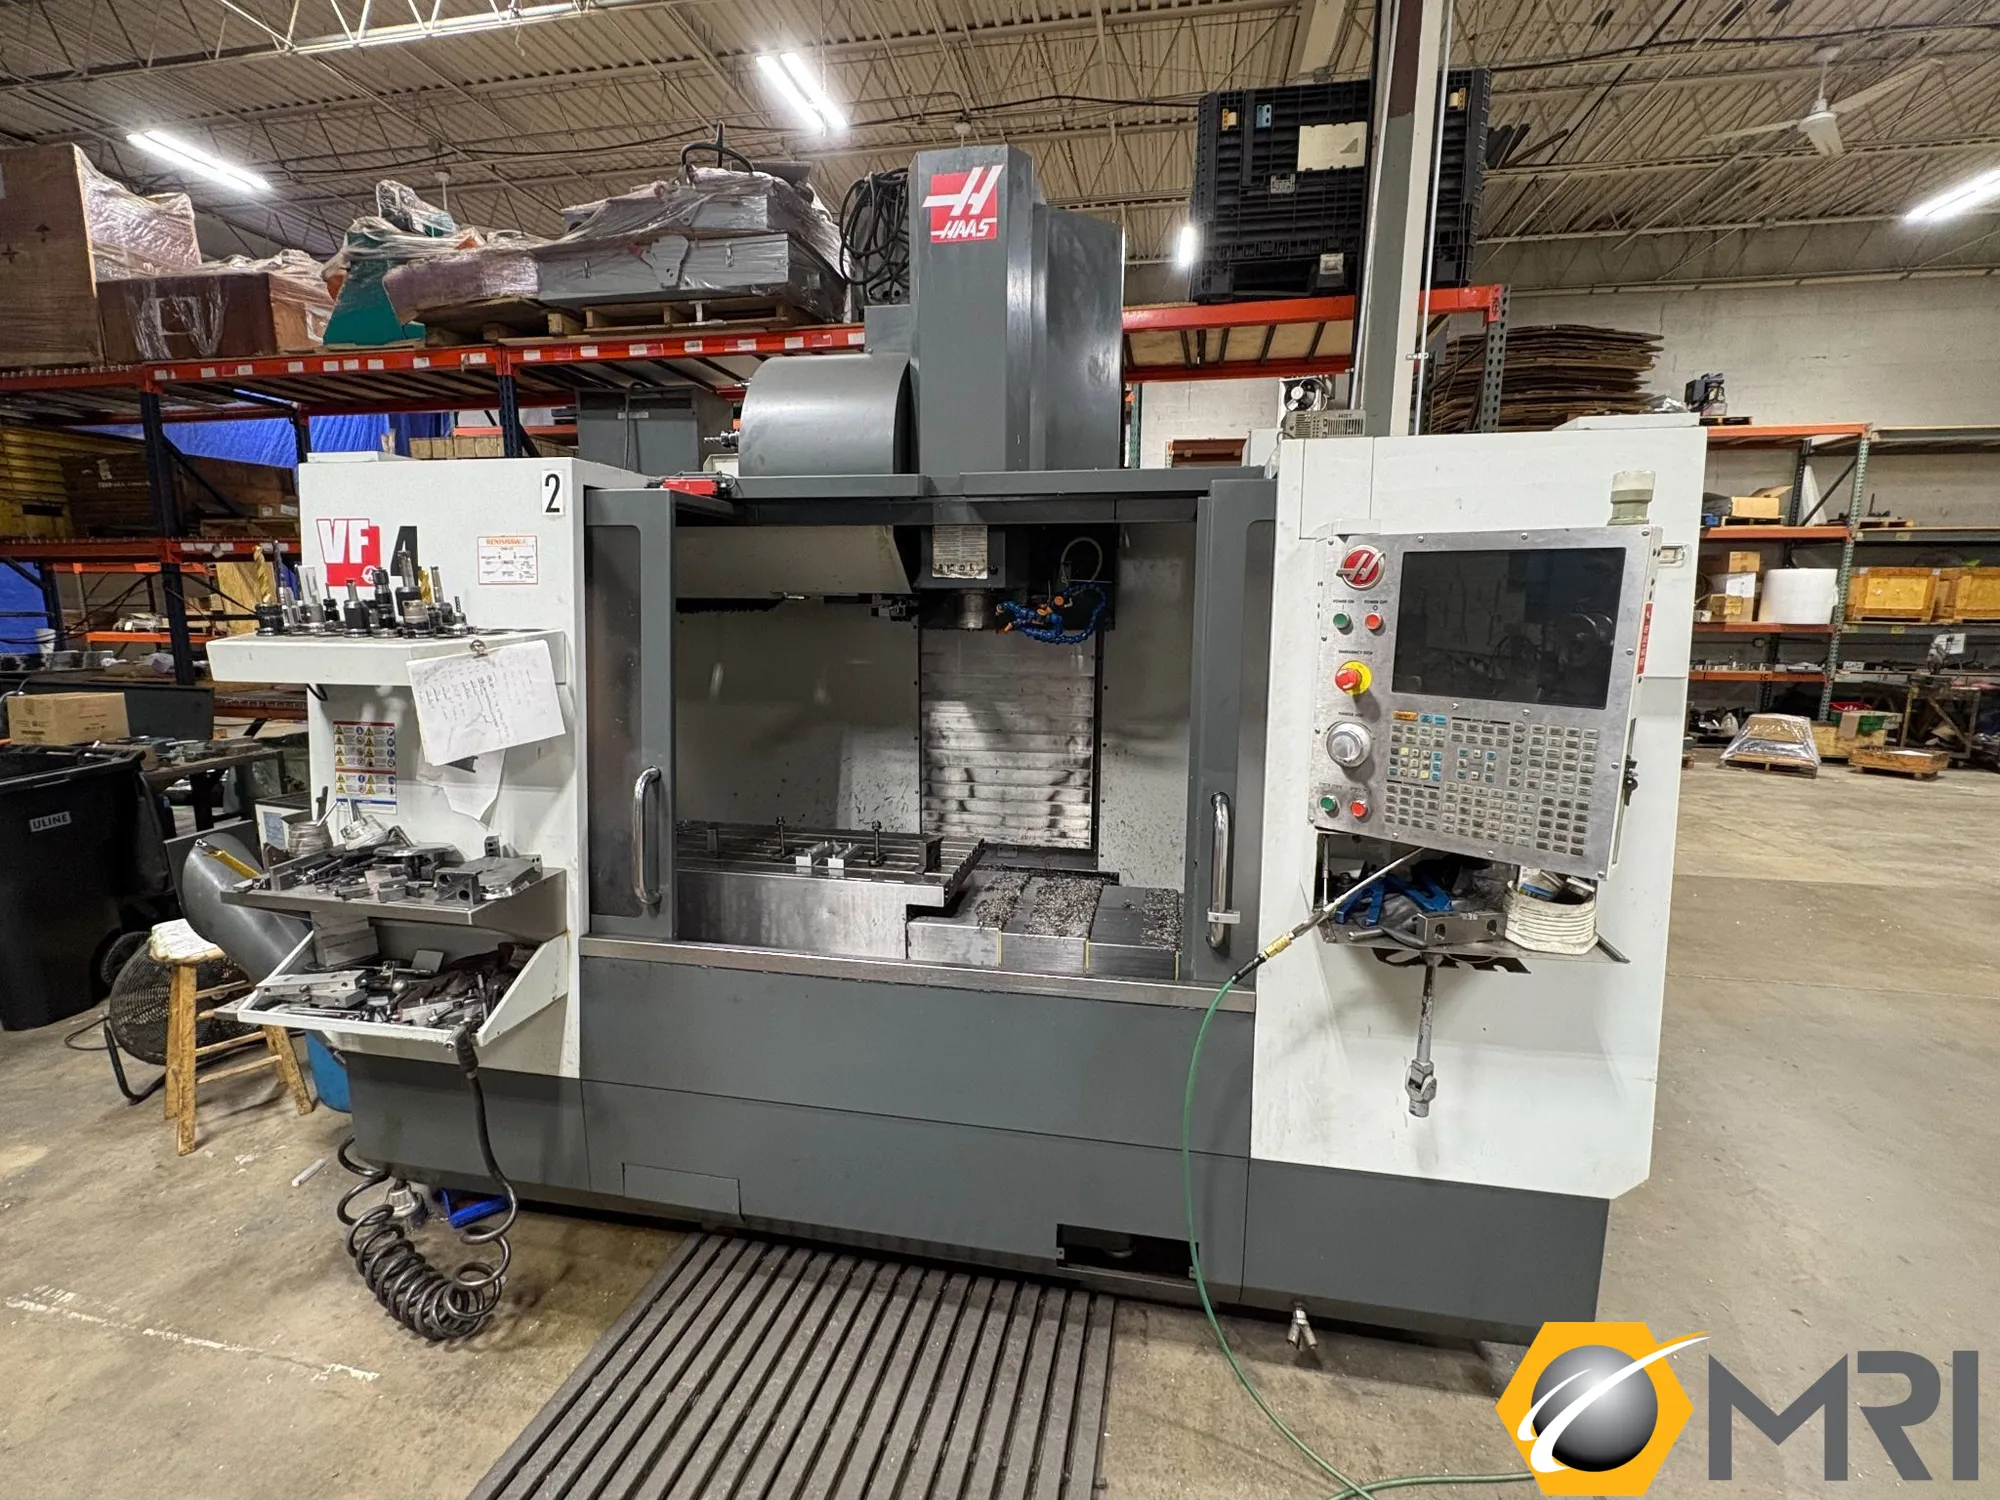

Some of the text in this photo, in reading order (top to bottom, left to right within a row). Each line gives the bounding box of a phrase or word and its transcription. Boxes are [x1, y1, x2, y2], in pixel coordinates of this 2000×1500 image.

[930, 217, 998, 240] HAAS
[544, 473, 561, 513] 2
[316, 518, 370, 565] VF
[30, 811, 71, 831] ULINE
